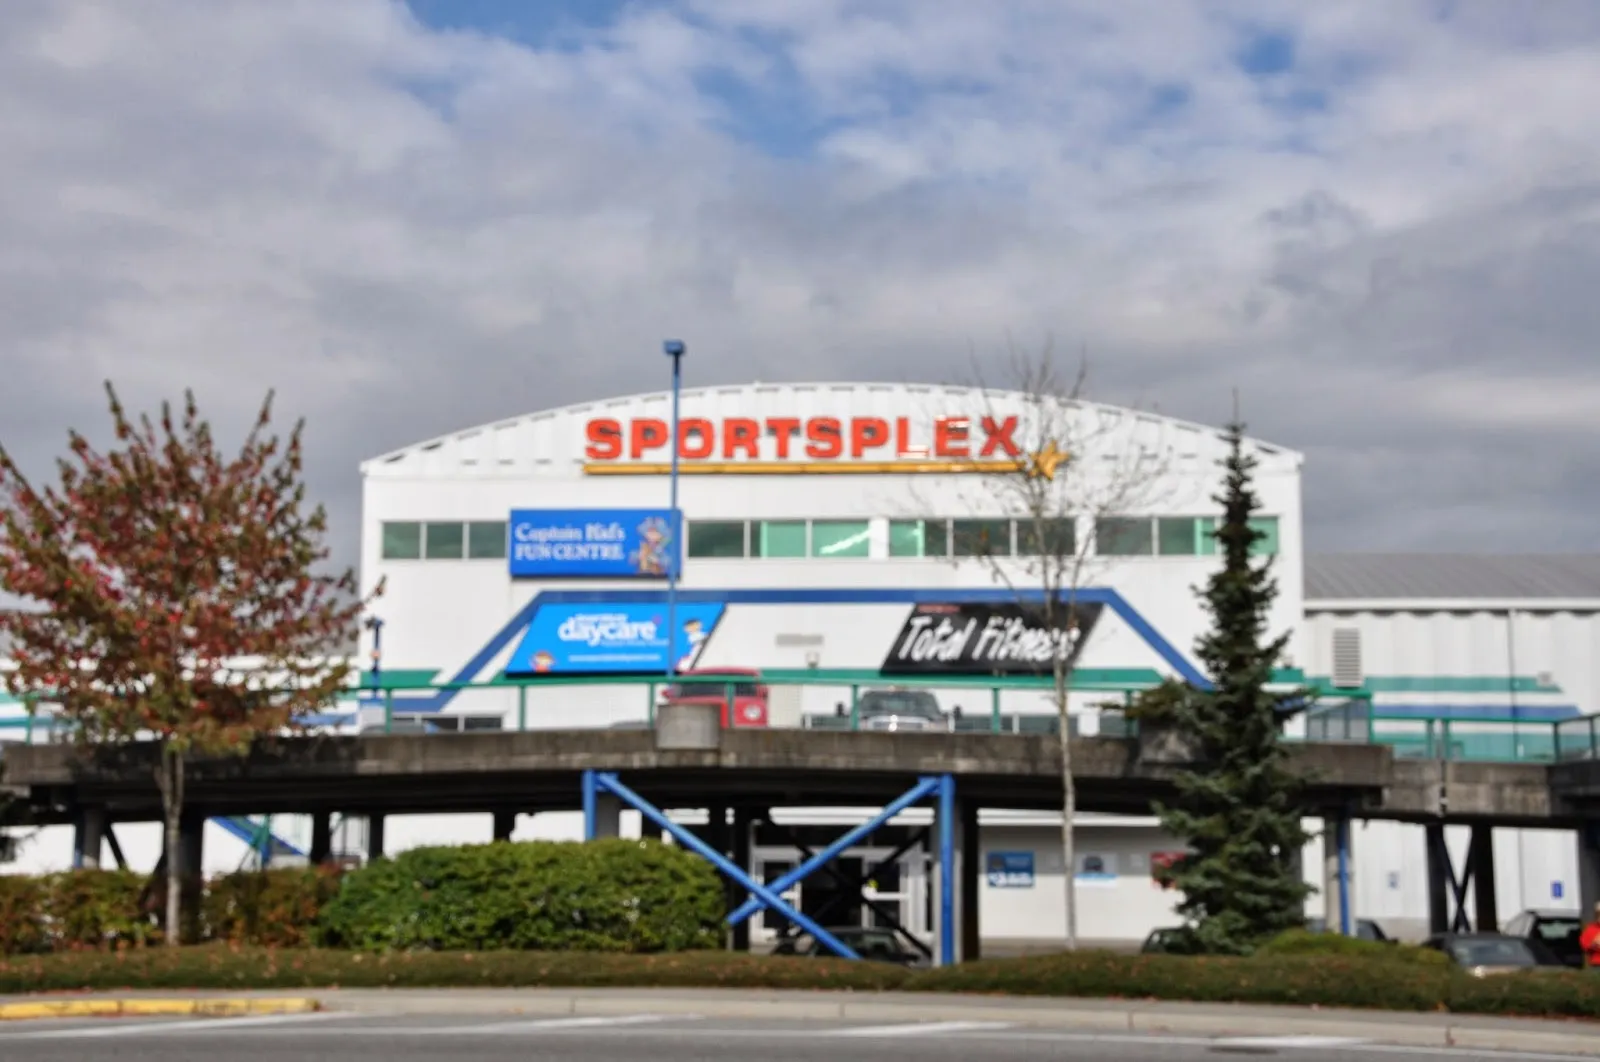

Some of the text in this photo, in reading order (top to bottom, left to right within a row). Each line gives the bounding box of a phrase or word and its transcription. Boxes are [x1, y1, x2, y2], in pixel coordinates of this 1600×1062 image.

[585, 416, 1021, 460] SPORTSPLEX
[515, 523, 583, 542] Captain
[515, 543, 551, 560] FUN
[558, 616, 656, 646] daycare
[898, 616, 977, 661] Total
